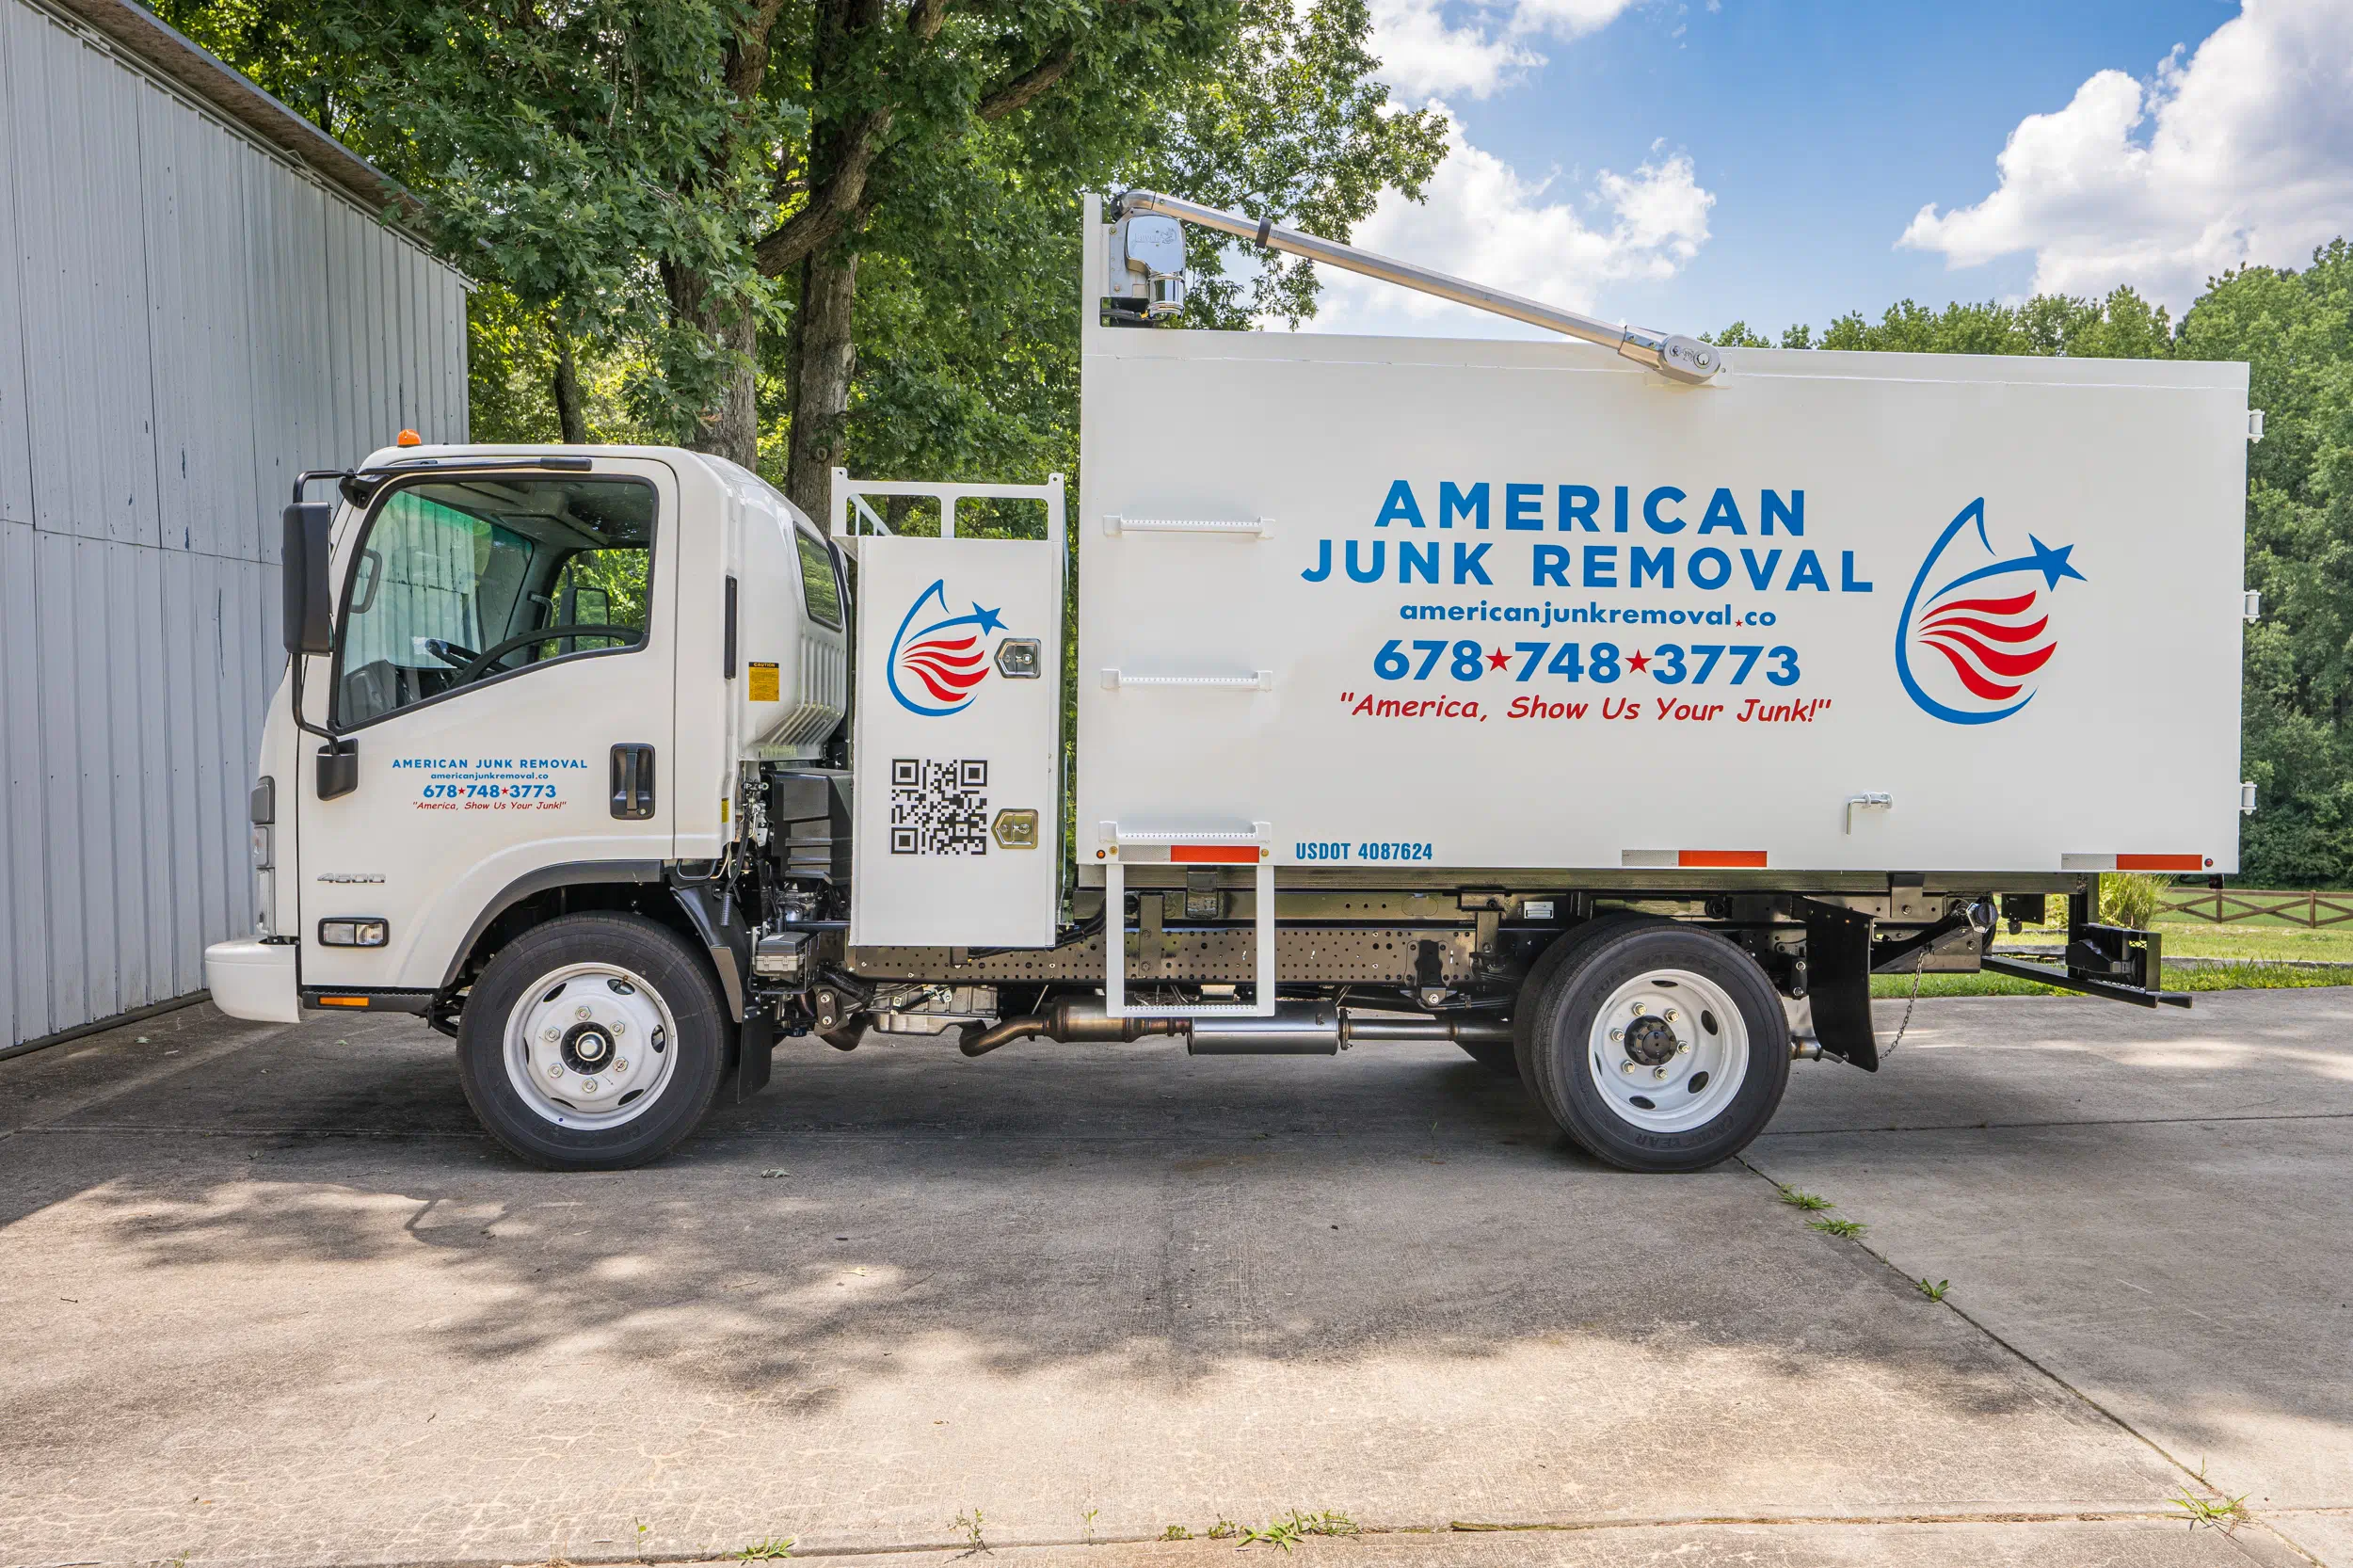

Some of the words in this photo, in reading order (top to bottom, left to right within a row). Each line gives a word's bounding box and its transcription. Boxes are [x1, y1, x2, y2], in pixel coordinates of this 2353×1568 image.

[1374, 479, 1805, 537] AMERICAN
[1300, 538, 1494, 585] JUNK
[1532, 543, 1874, 593] REMOVAL
[1399, 599, 1777, 630] americanjunkremoval.co
[1339, 692, 1488, 723] "America,
[1507, 694, 1590, 720] Show
[1602, 696, 1641, 721] Us
[1657, 696, 1725, 722] Your
[1737, 698, 1833, 723] Junk!"
[392, 759, 468, 769] AMERICAN
[475, 759, 513, 769] JUNK
[520, 759, 588, 769] REMOVAL
[430, 772, 549, 781] americanjunkremoval.co
[412, 801, 459, 810] "America,
[464, 801, 489, 809] Show
[493, 801, 506, 809] Us
[511, 801, 533, 809] Your
[536, 801, 567, 809] Junk!"
[1295, 842, 1352, 860] USDOT
[1357, 842, 1433, 861] 4087624
